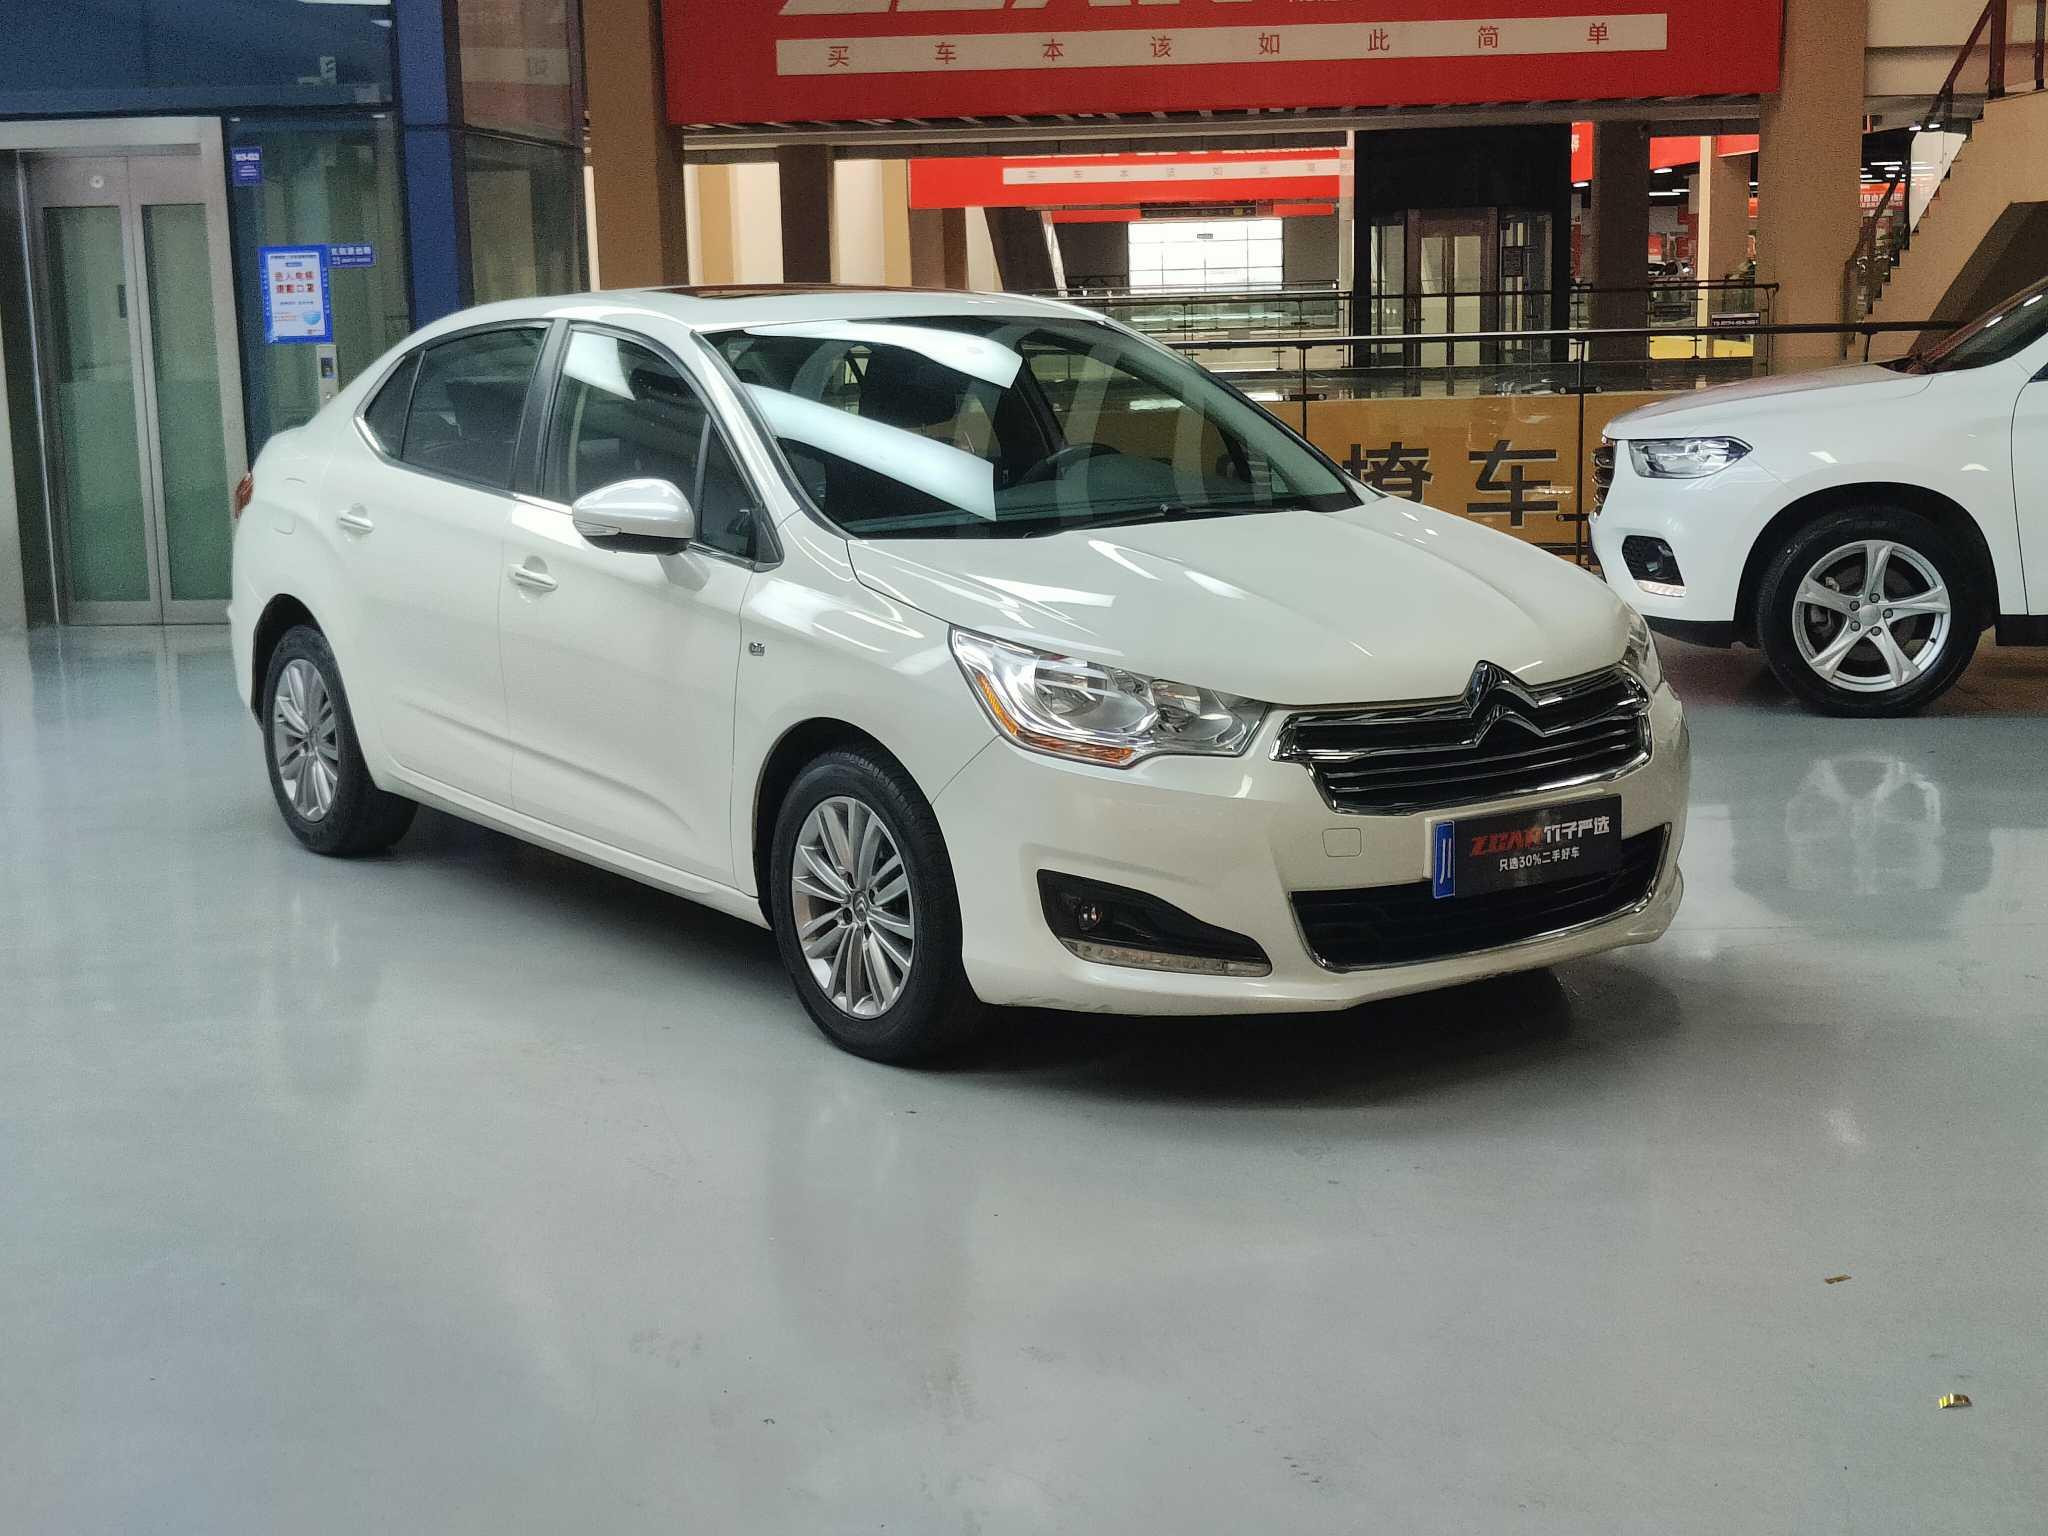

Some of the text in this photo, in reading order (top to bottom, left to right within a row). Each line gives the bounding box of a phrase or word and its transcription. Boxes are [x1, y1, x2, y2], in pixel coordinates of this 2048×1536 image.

[827, 22, 1611, 69] 买车本该如此简单
